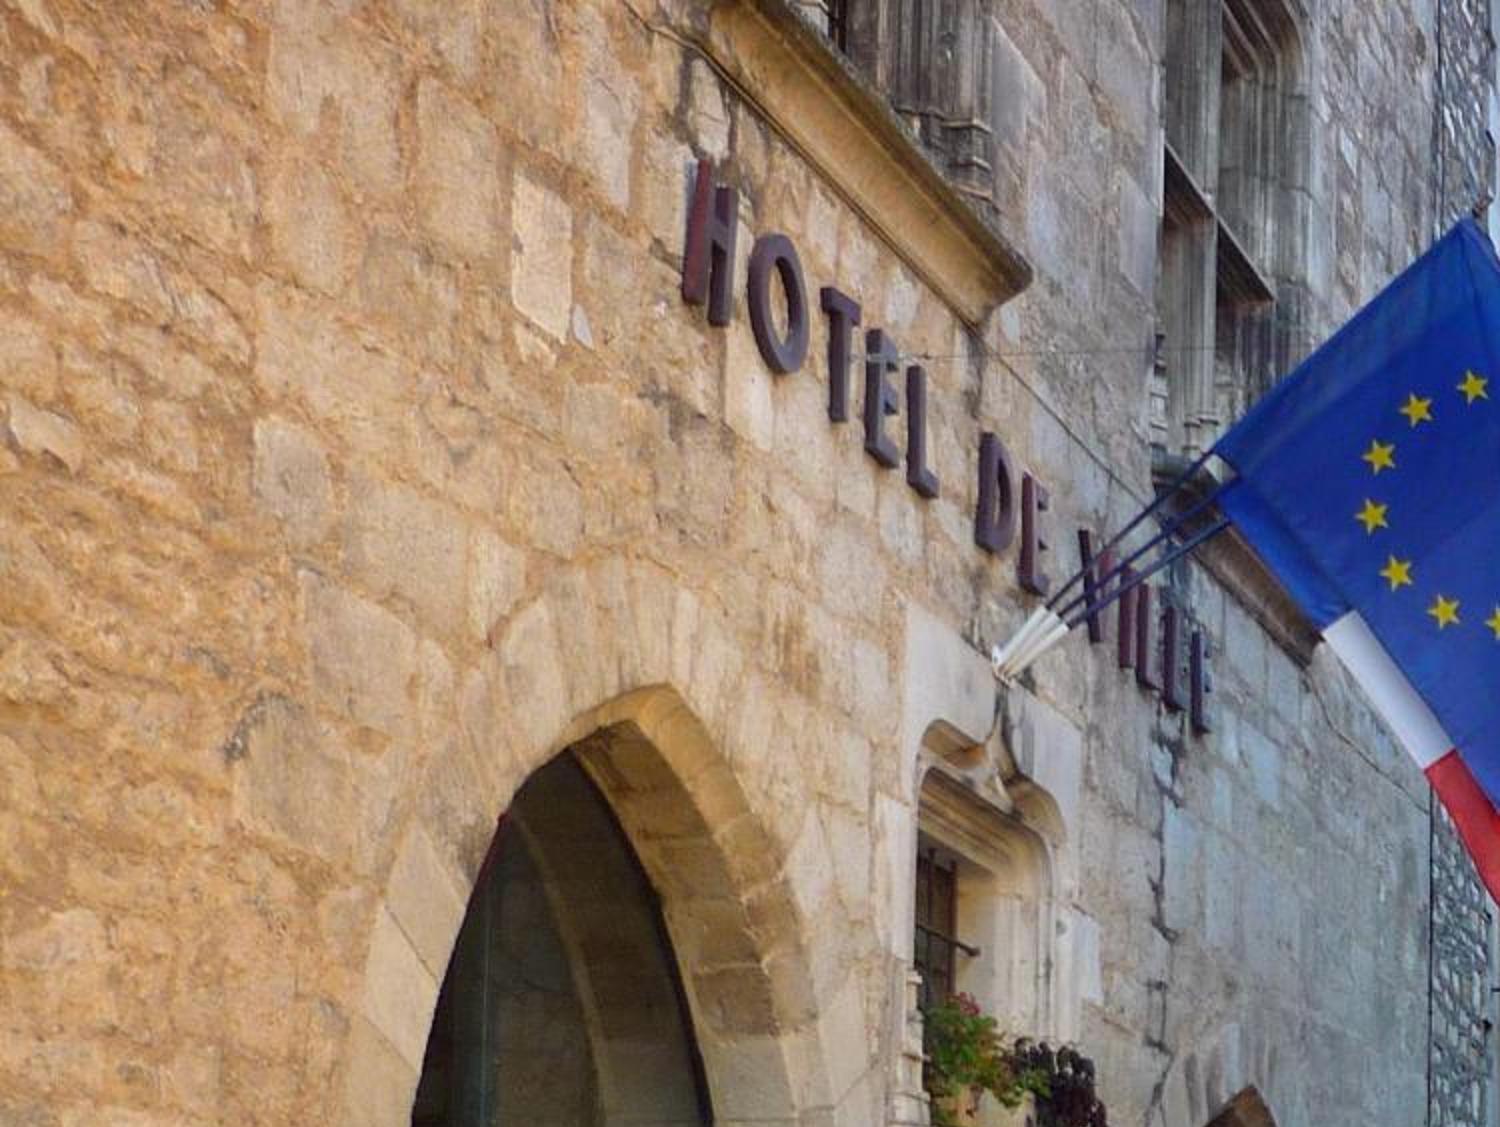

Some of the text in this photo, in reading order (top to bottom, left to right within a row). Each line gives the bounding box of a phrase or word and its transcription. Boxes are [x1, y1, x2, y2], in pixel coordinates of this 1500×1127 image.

[682, 158, 1215, 736] HOTEL DE VILLE
